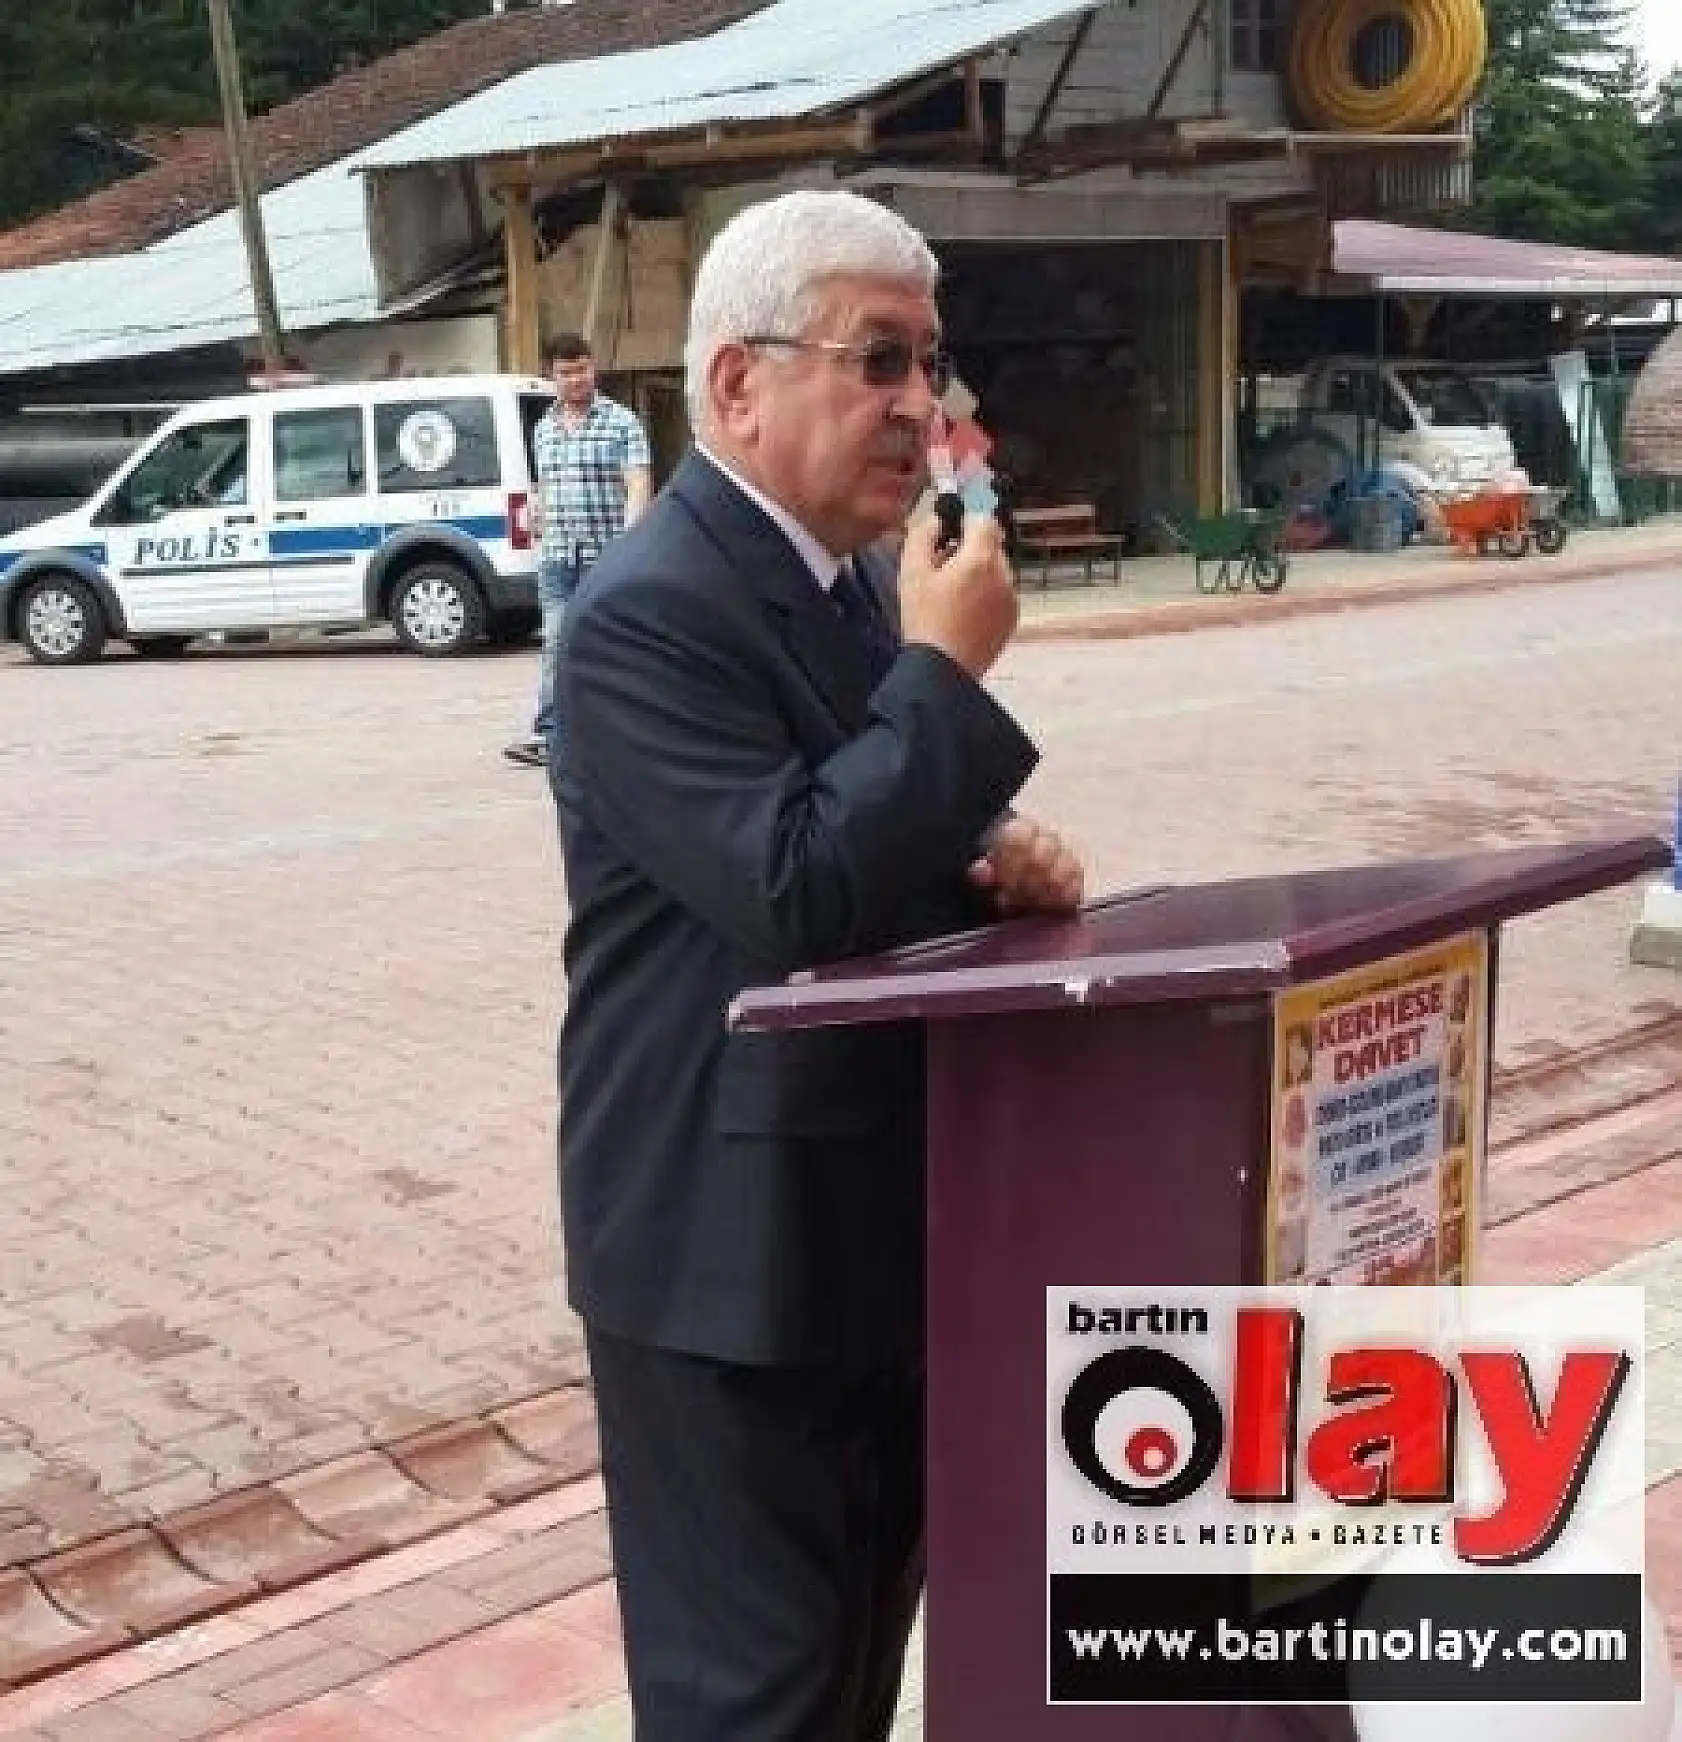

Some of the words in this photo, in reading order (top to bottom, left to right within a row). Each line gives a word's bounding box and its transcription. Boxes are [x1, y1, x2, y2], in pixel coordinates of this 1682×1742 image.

[134, 526, 240, 565] POLİS
[1319, 983, 1444, 1049] KERMESE
[1334, 1025, 1428, 1084] DAVET
